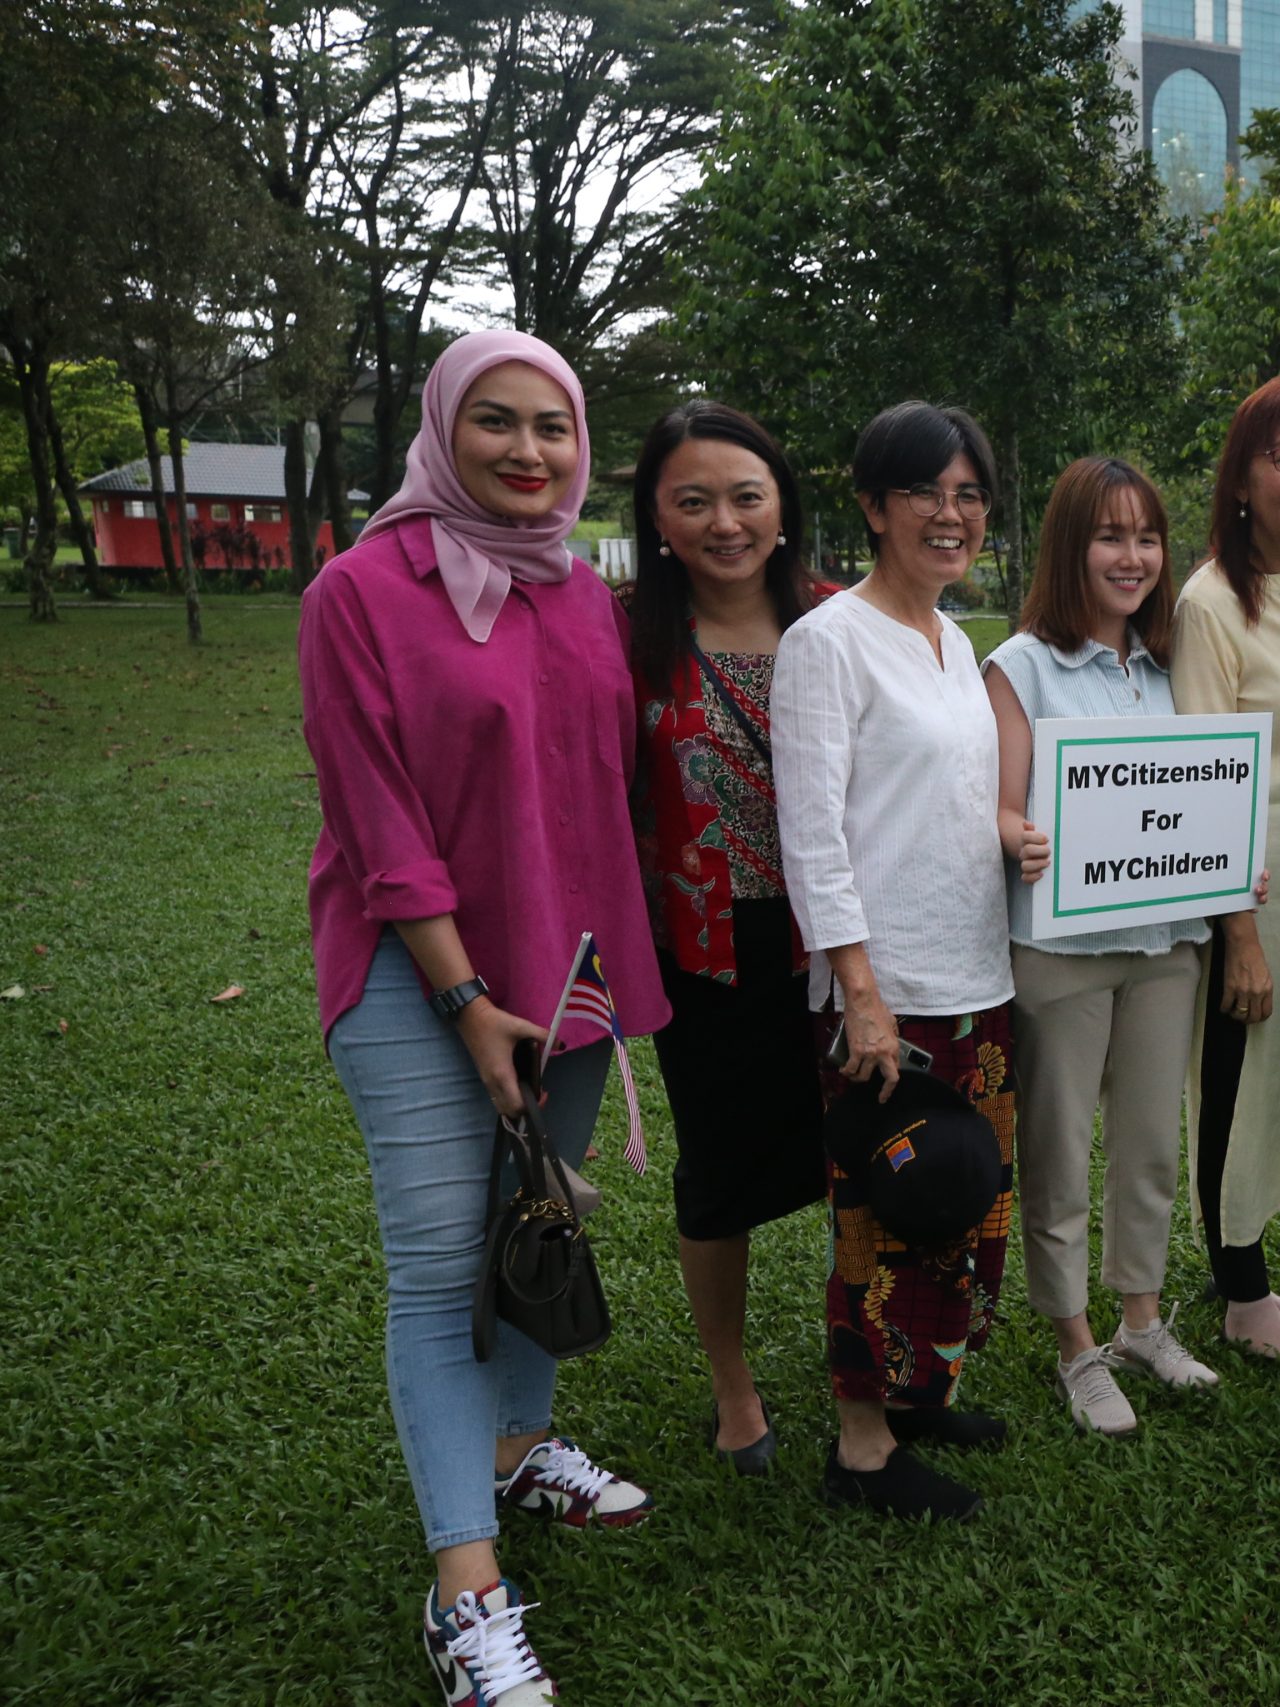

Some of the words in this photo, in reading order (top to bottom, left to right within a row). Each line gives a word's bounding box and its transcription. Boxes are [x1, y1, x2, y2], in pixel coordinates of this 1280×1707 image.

[1067, 758, 1250, 790] MYCitizenship
[1140, 809, 1183, 832] For
[1083, 852, 1229, 885] MYChildren
